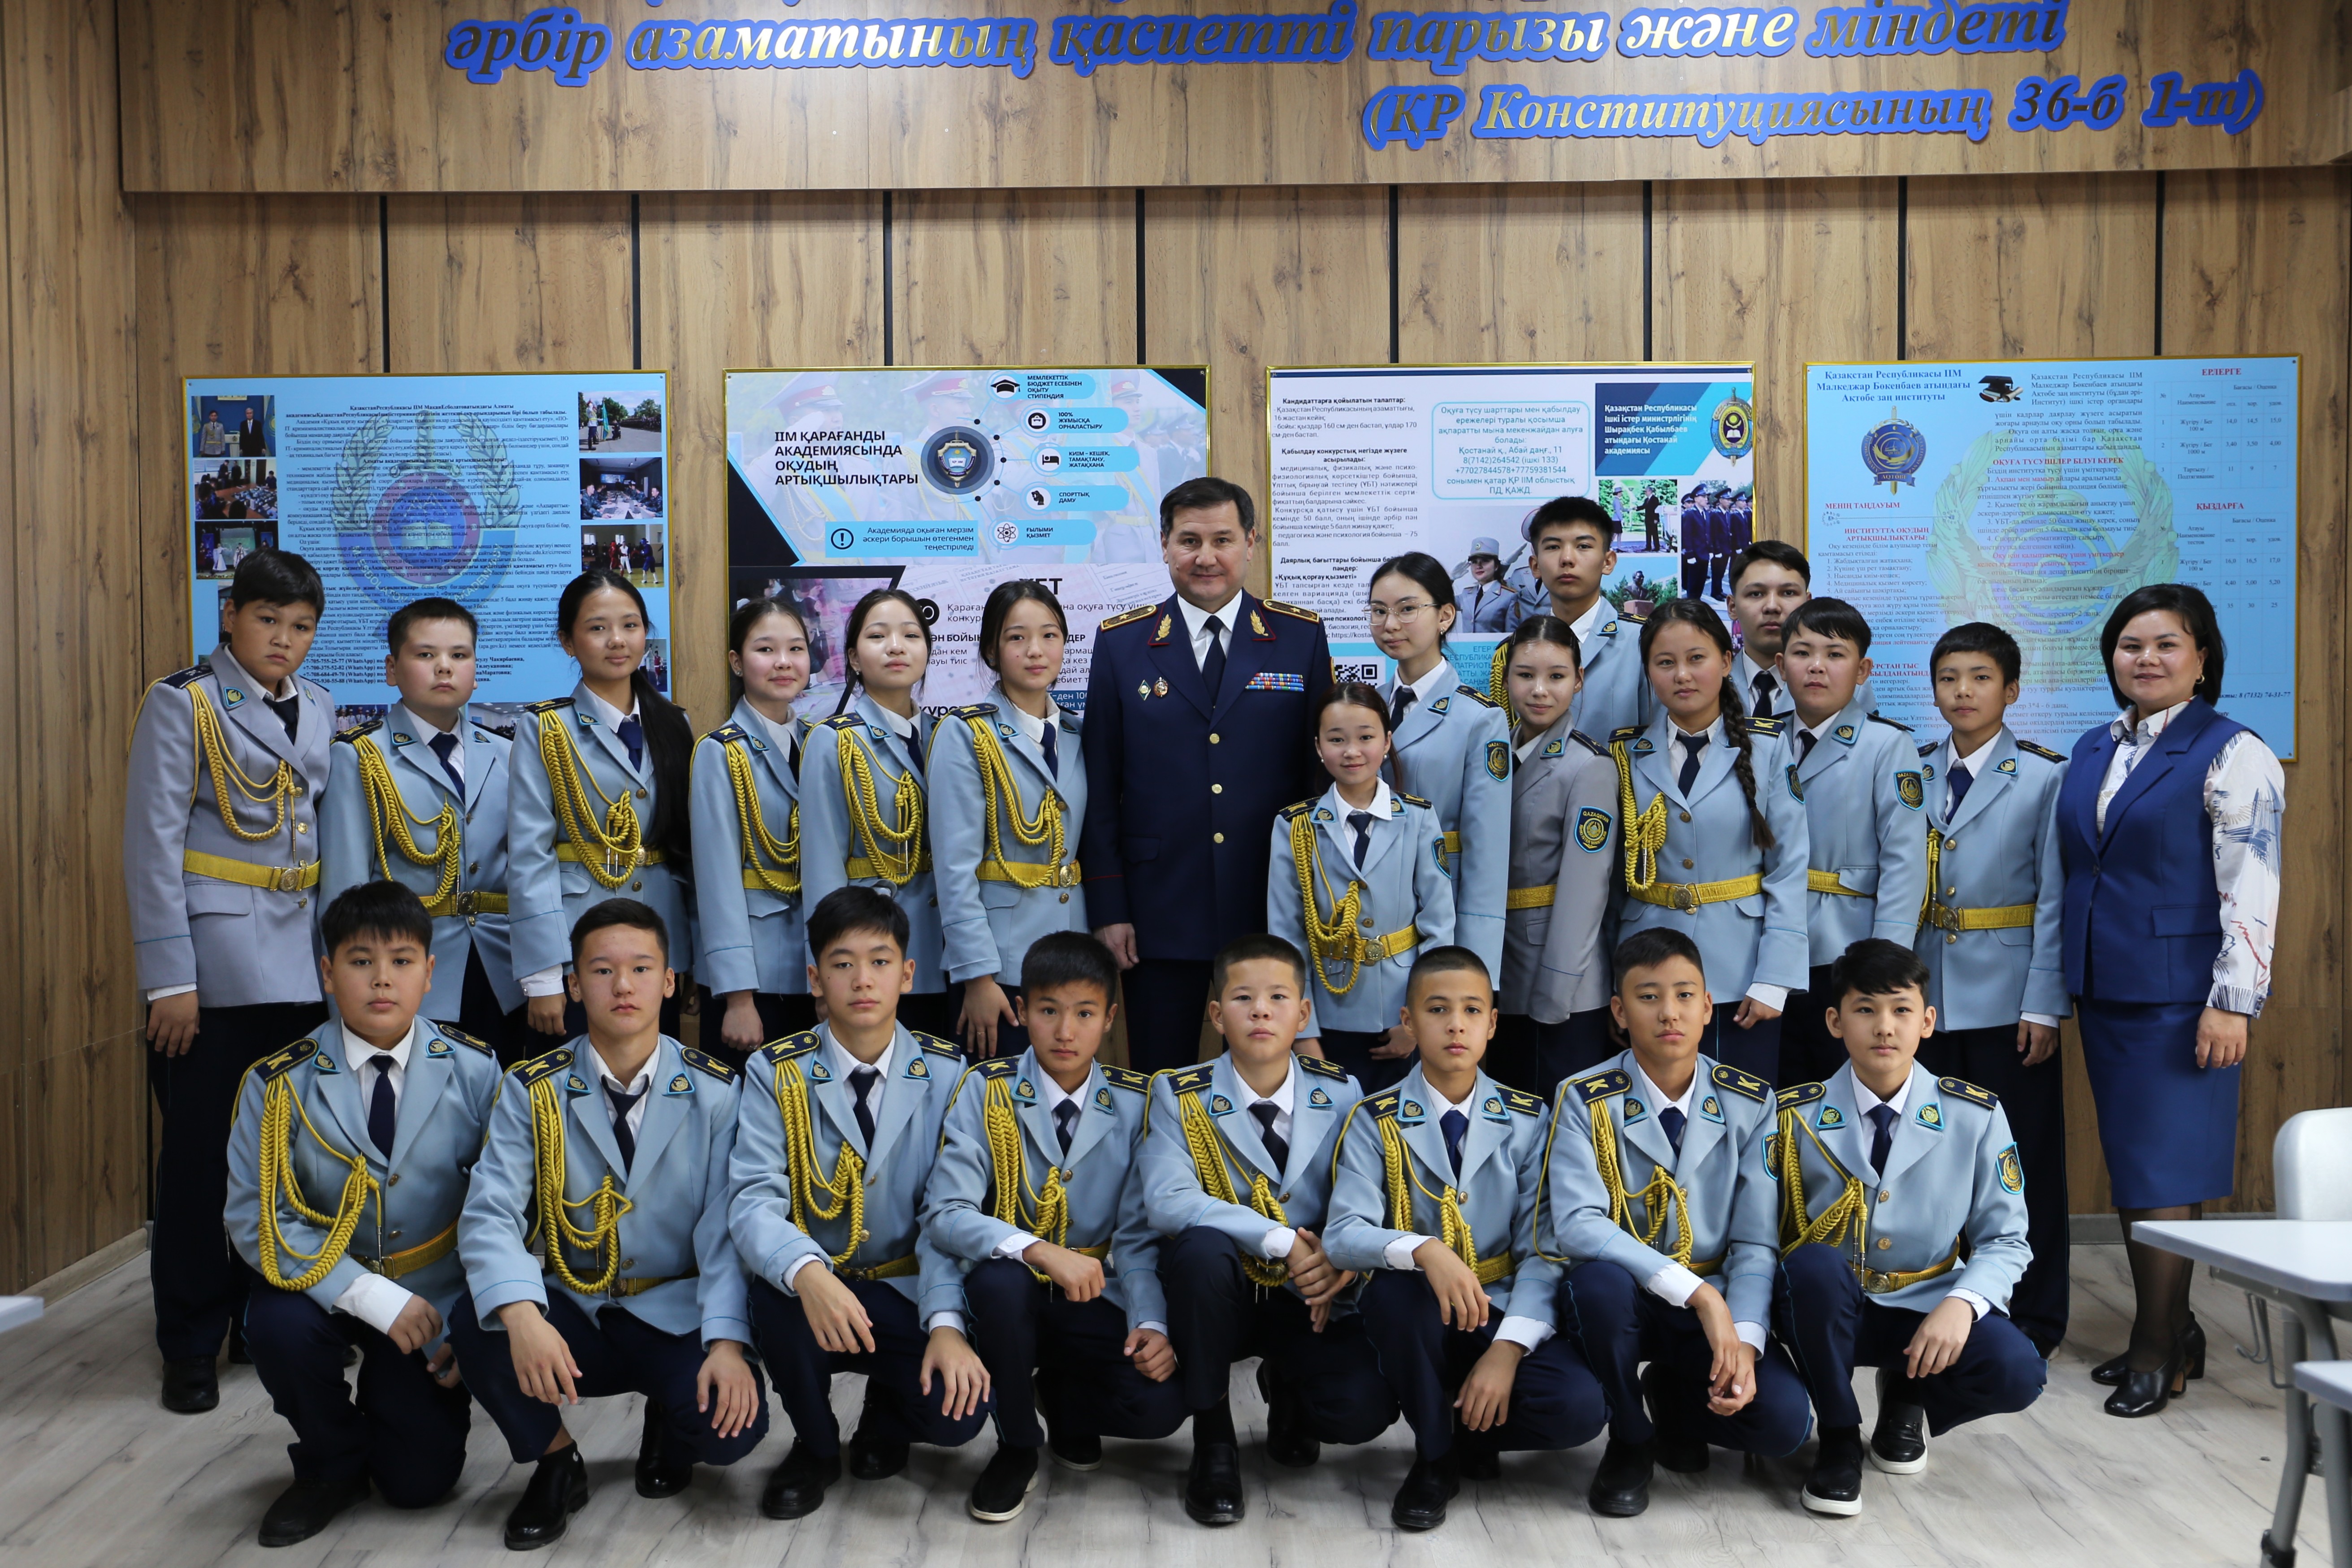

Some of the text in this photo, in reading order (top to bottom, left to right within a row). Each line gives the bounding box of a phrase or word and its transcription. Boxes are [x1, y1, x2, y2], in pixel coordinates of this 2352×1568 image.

[454, 0, 2063, 76] әрбір азаматының қасиетті парызы және міндеті
[1371, 92, 1460, 142] (ҚР
[1486, 91, 1983, 137] Конституциясының
[2018, 82, 2116, 124] 36-б
[1876, 370, 1941, 380] Республикасы
[1816, 383, 1870, 391] Малкеджар
[1896, 394, 1945, 403] институты
[1441, 407, 1463, 415] Оқуға
[1542, 406, 1580, 414] қабылдау
[1605, 404, 1697, 413] Қазақстан Республикасы
[1622, 415, 1640, 423] істер
[1642, 415, 1697, 423] министрлігінің
[1646, 426, 1687, 434] Қабылбаев
[775, 431, 885, 443] ІІМ ҚАРАҒАНДЫ
[1643, 436, 1677, 444] Қостанай
[775, 445, 902, 457] АКАДЕМИЯСЫНДА
[1459, 446, 1495, 455] Қостанай
[1464, 457, 1519, 465] 8(7142)264542
[775, 460, 838, 472] ОҚУДЫҢ
[775, 474, 918, 487] АРТЫҚШЫЛЫҚТАРЫ
[1078, 603, 1103, 611] оқуға
[1583, 811, 1609, 823] QAZAQSTAN
